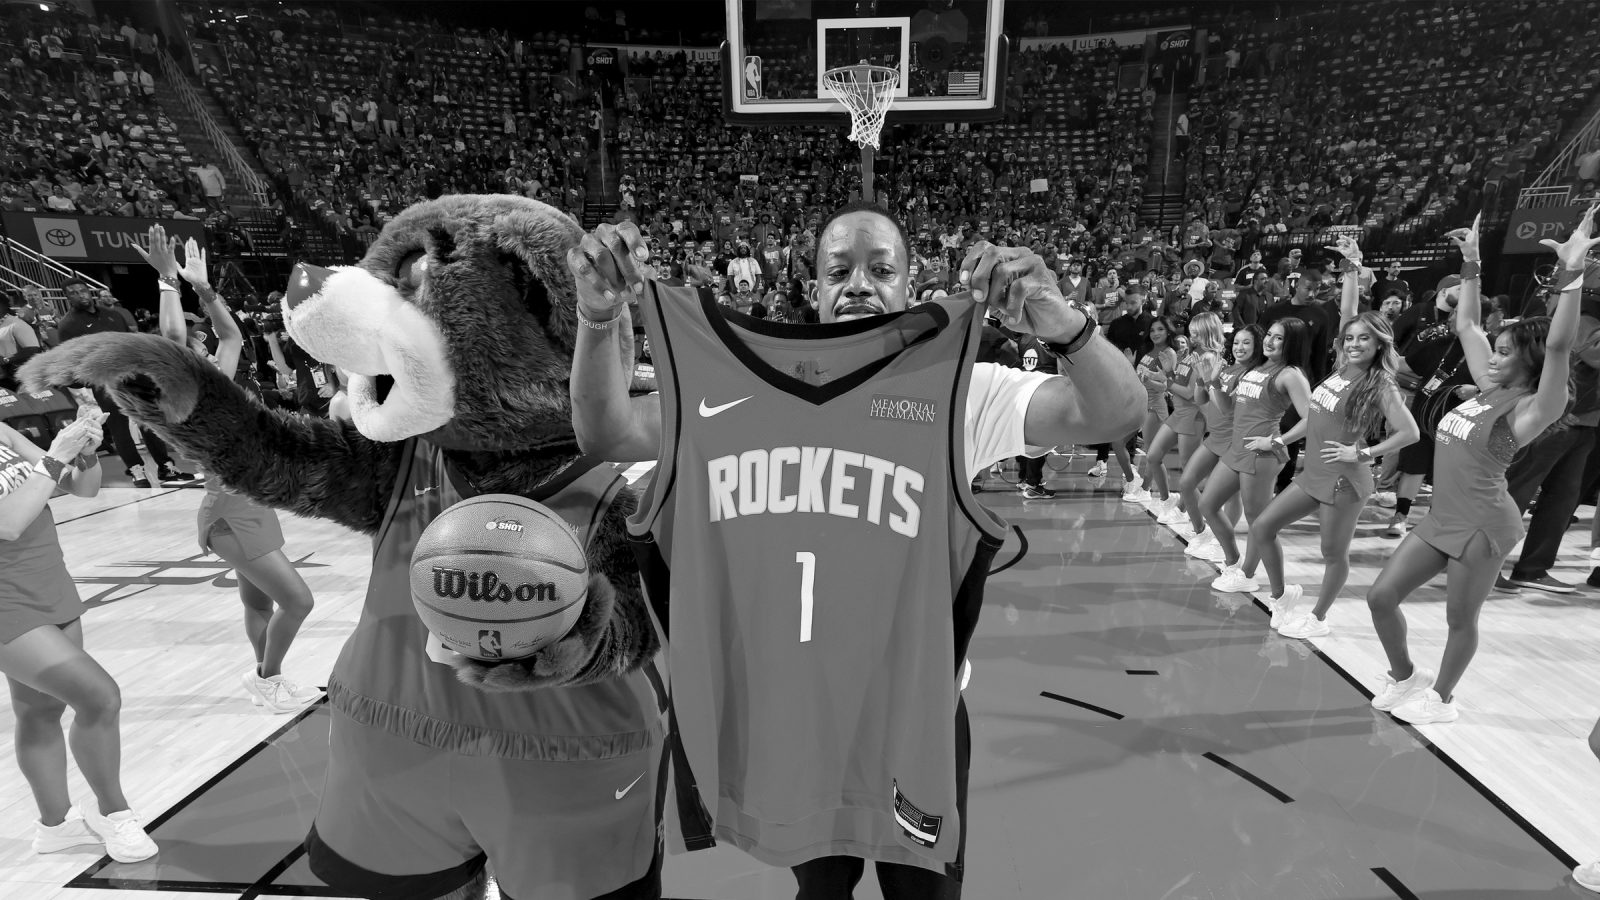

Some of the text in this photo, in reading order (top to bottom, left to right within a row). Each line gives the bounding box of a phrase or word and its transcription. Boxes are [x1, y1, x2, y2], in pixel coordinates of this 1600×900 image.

[1169, 38, 1190, 49] SHOT
[595, 56, 613, 65] SHOT
[1540, 222, 1565, 236] PN
[90, 231, 186, 250] TUNDA
[871, 398, 936, 414] MEMORIAL
[869, 407, 935, 422] HERMANN
[707, 446, 925, 538] ROCKETS
[498, 522, 524, 532] SHOT
[432, 566, 558, 604] Wilson
[796, 551, 816, 643] 1
